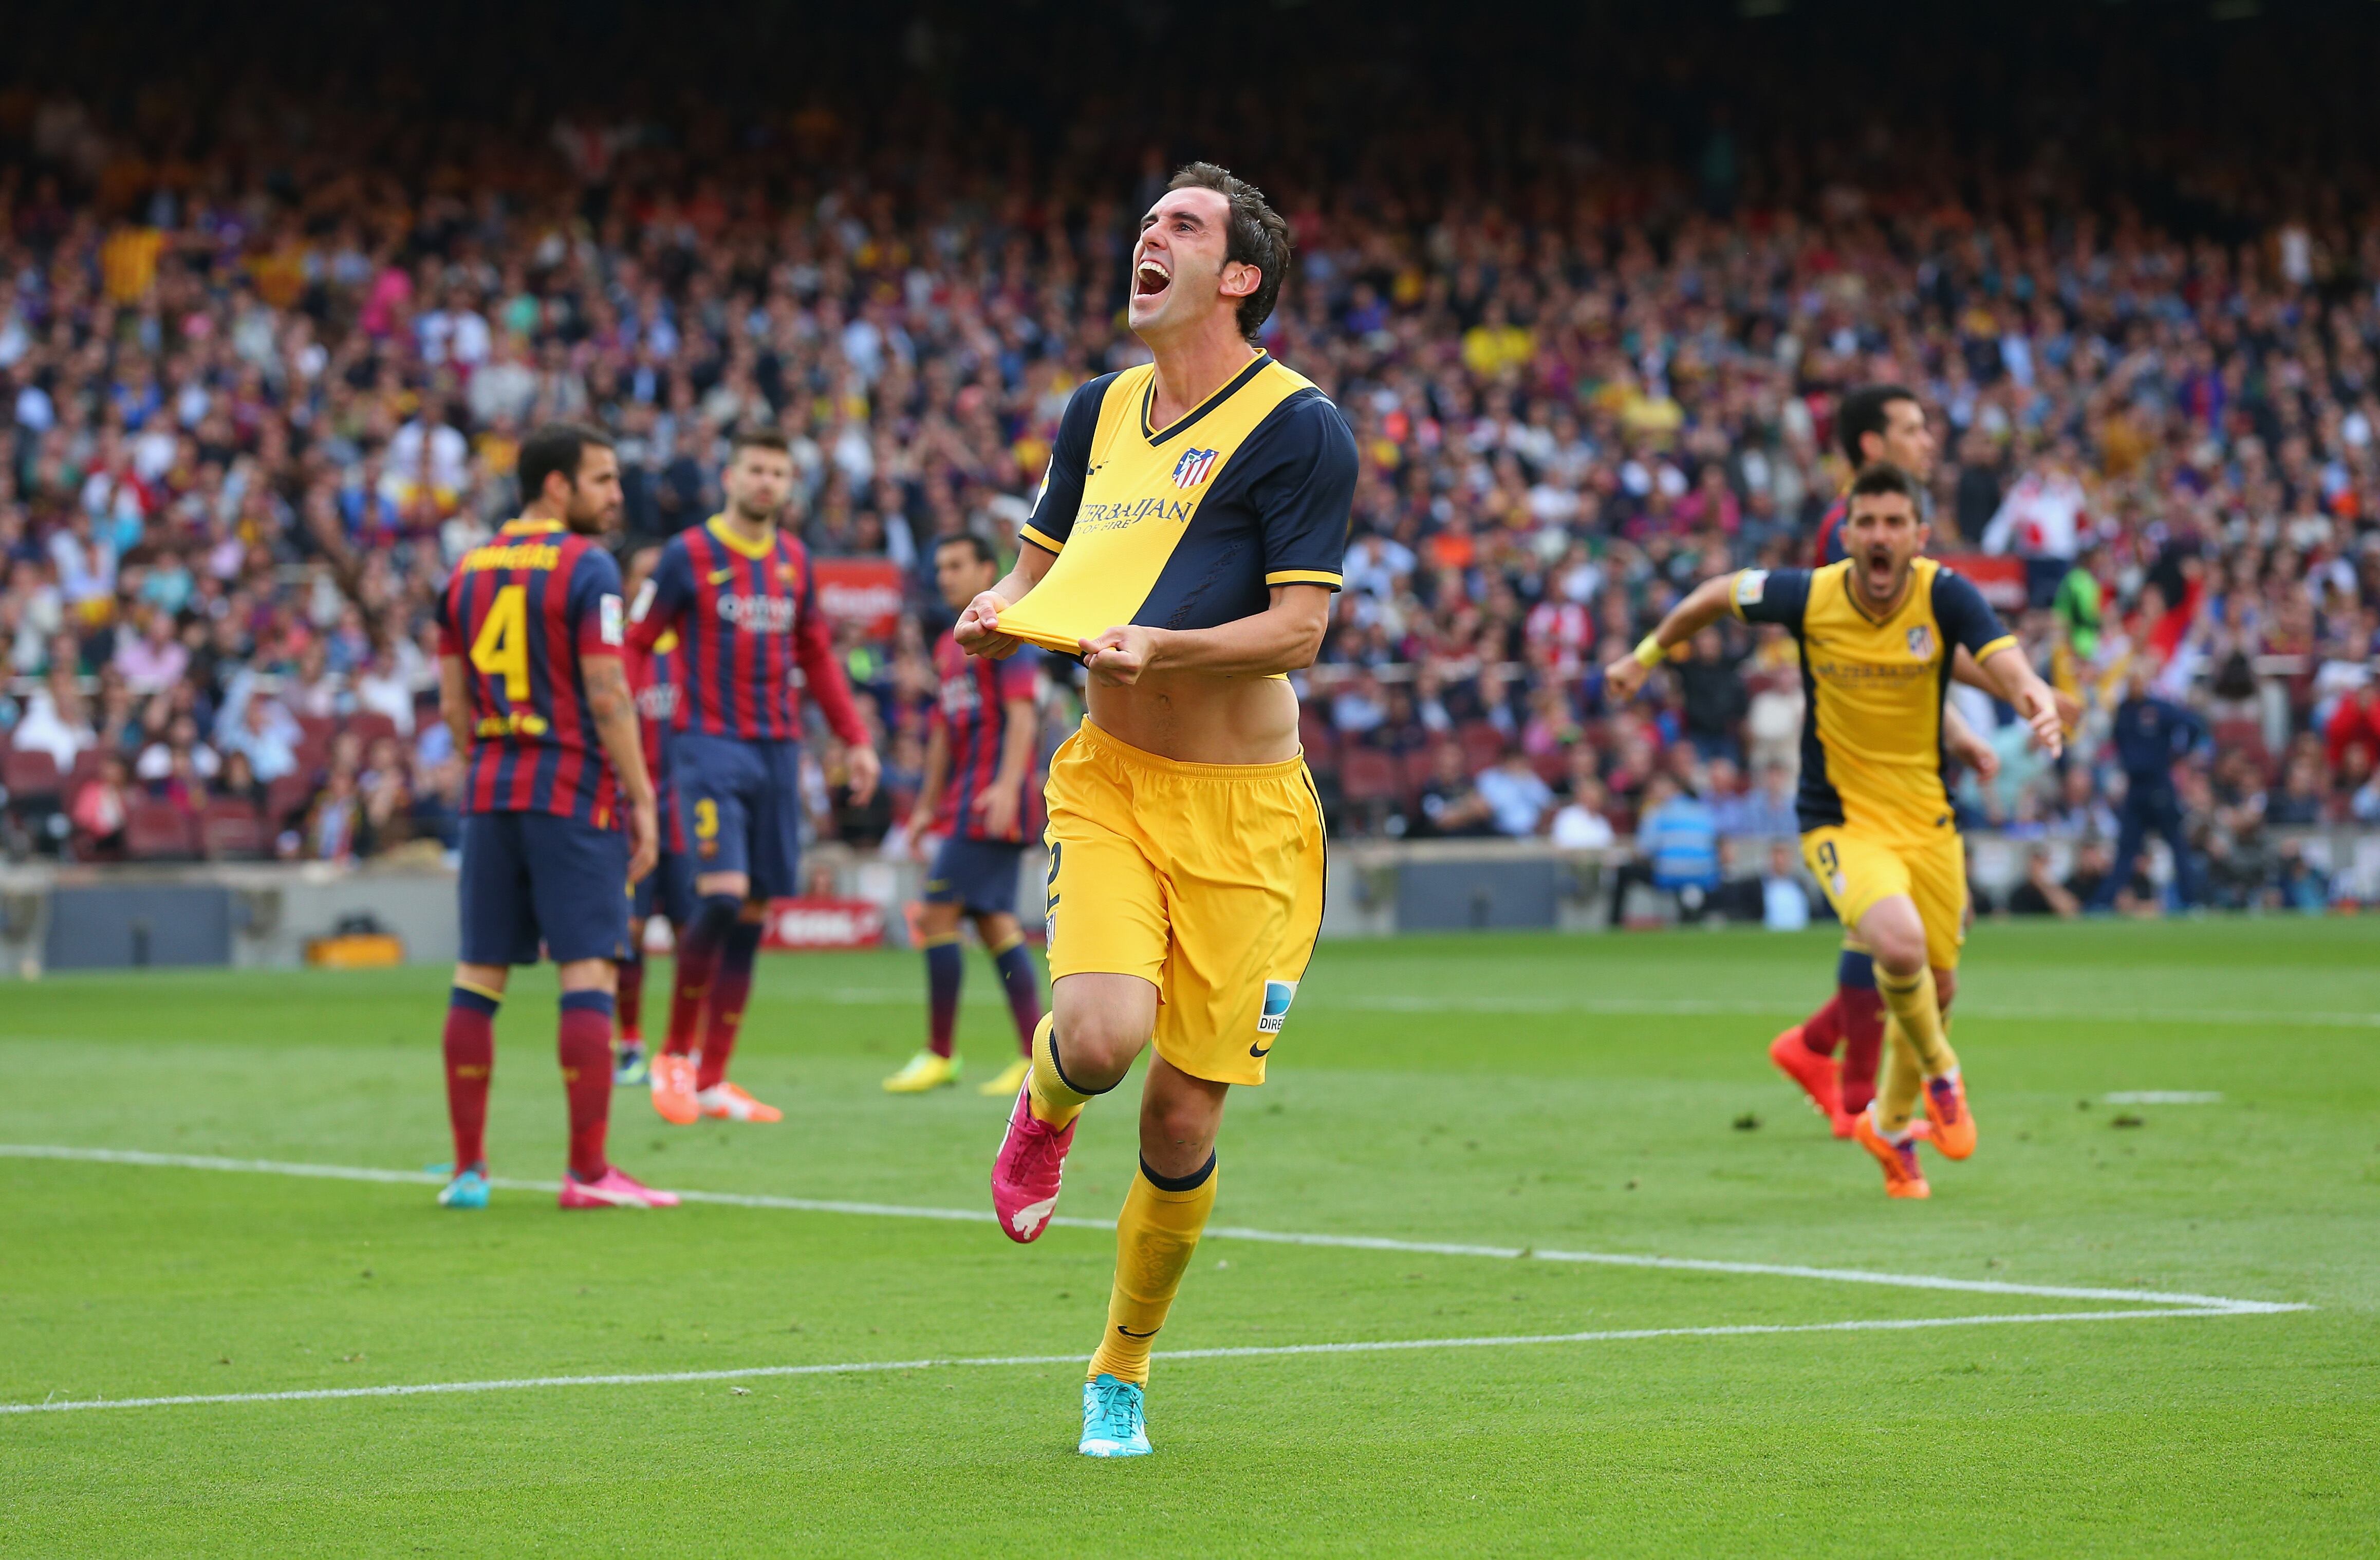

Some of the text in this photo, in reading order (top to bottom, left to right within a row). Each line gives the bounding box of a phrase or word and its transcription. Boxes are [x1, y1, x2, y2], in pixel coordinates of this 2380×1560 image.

[1101, 519, 1131, 531] FIRE
[470, 584, 530, 701] 4
[694, 797, 719, 839] 3
[1817, 841, 1838, 877] 9
[1259, 1018, 1285, 1030] DIRE
